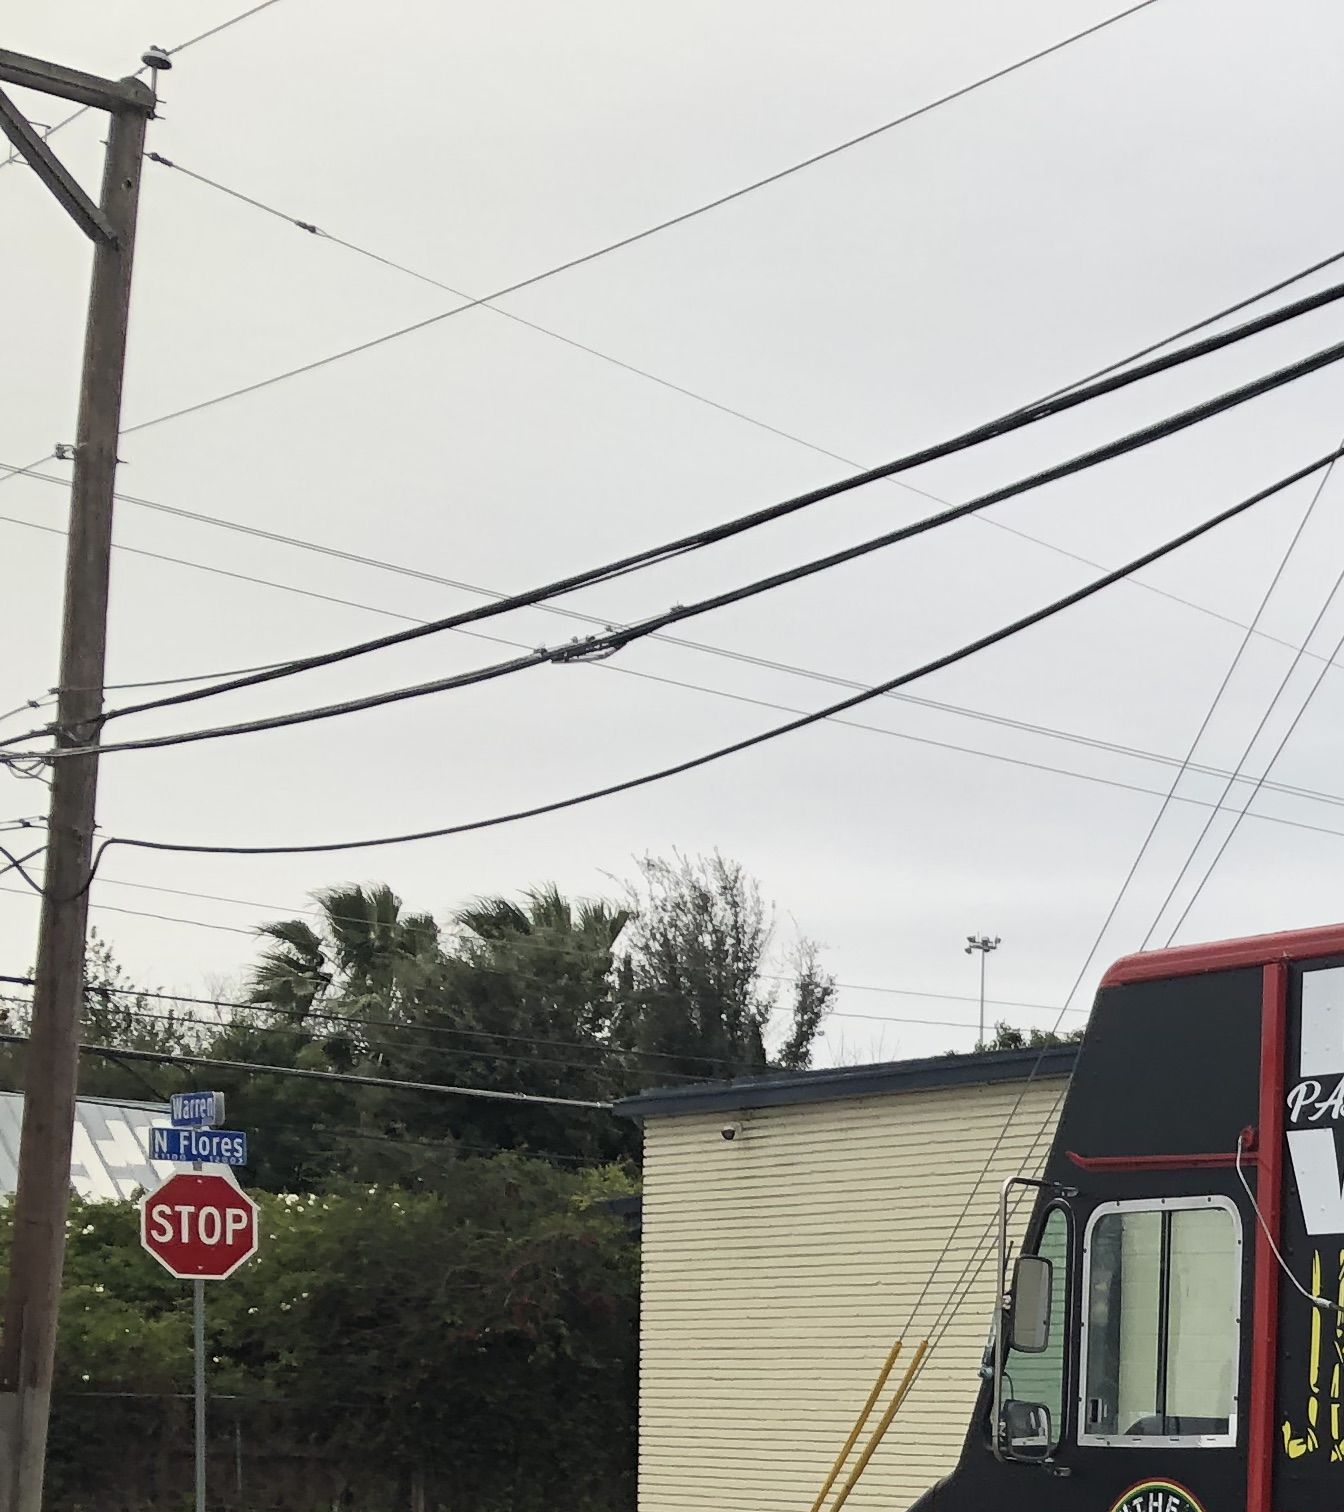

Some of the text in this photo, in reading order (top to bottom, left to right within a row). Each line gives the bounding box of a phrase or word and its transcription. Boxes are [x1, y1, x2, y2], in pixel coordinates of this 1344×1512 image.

[172, 1096, 214, 1119] Warren
[155, 1130, 243, 1158] N Flores
[150, 1204, 248, 1245] STOP
